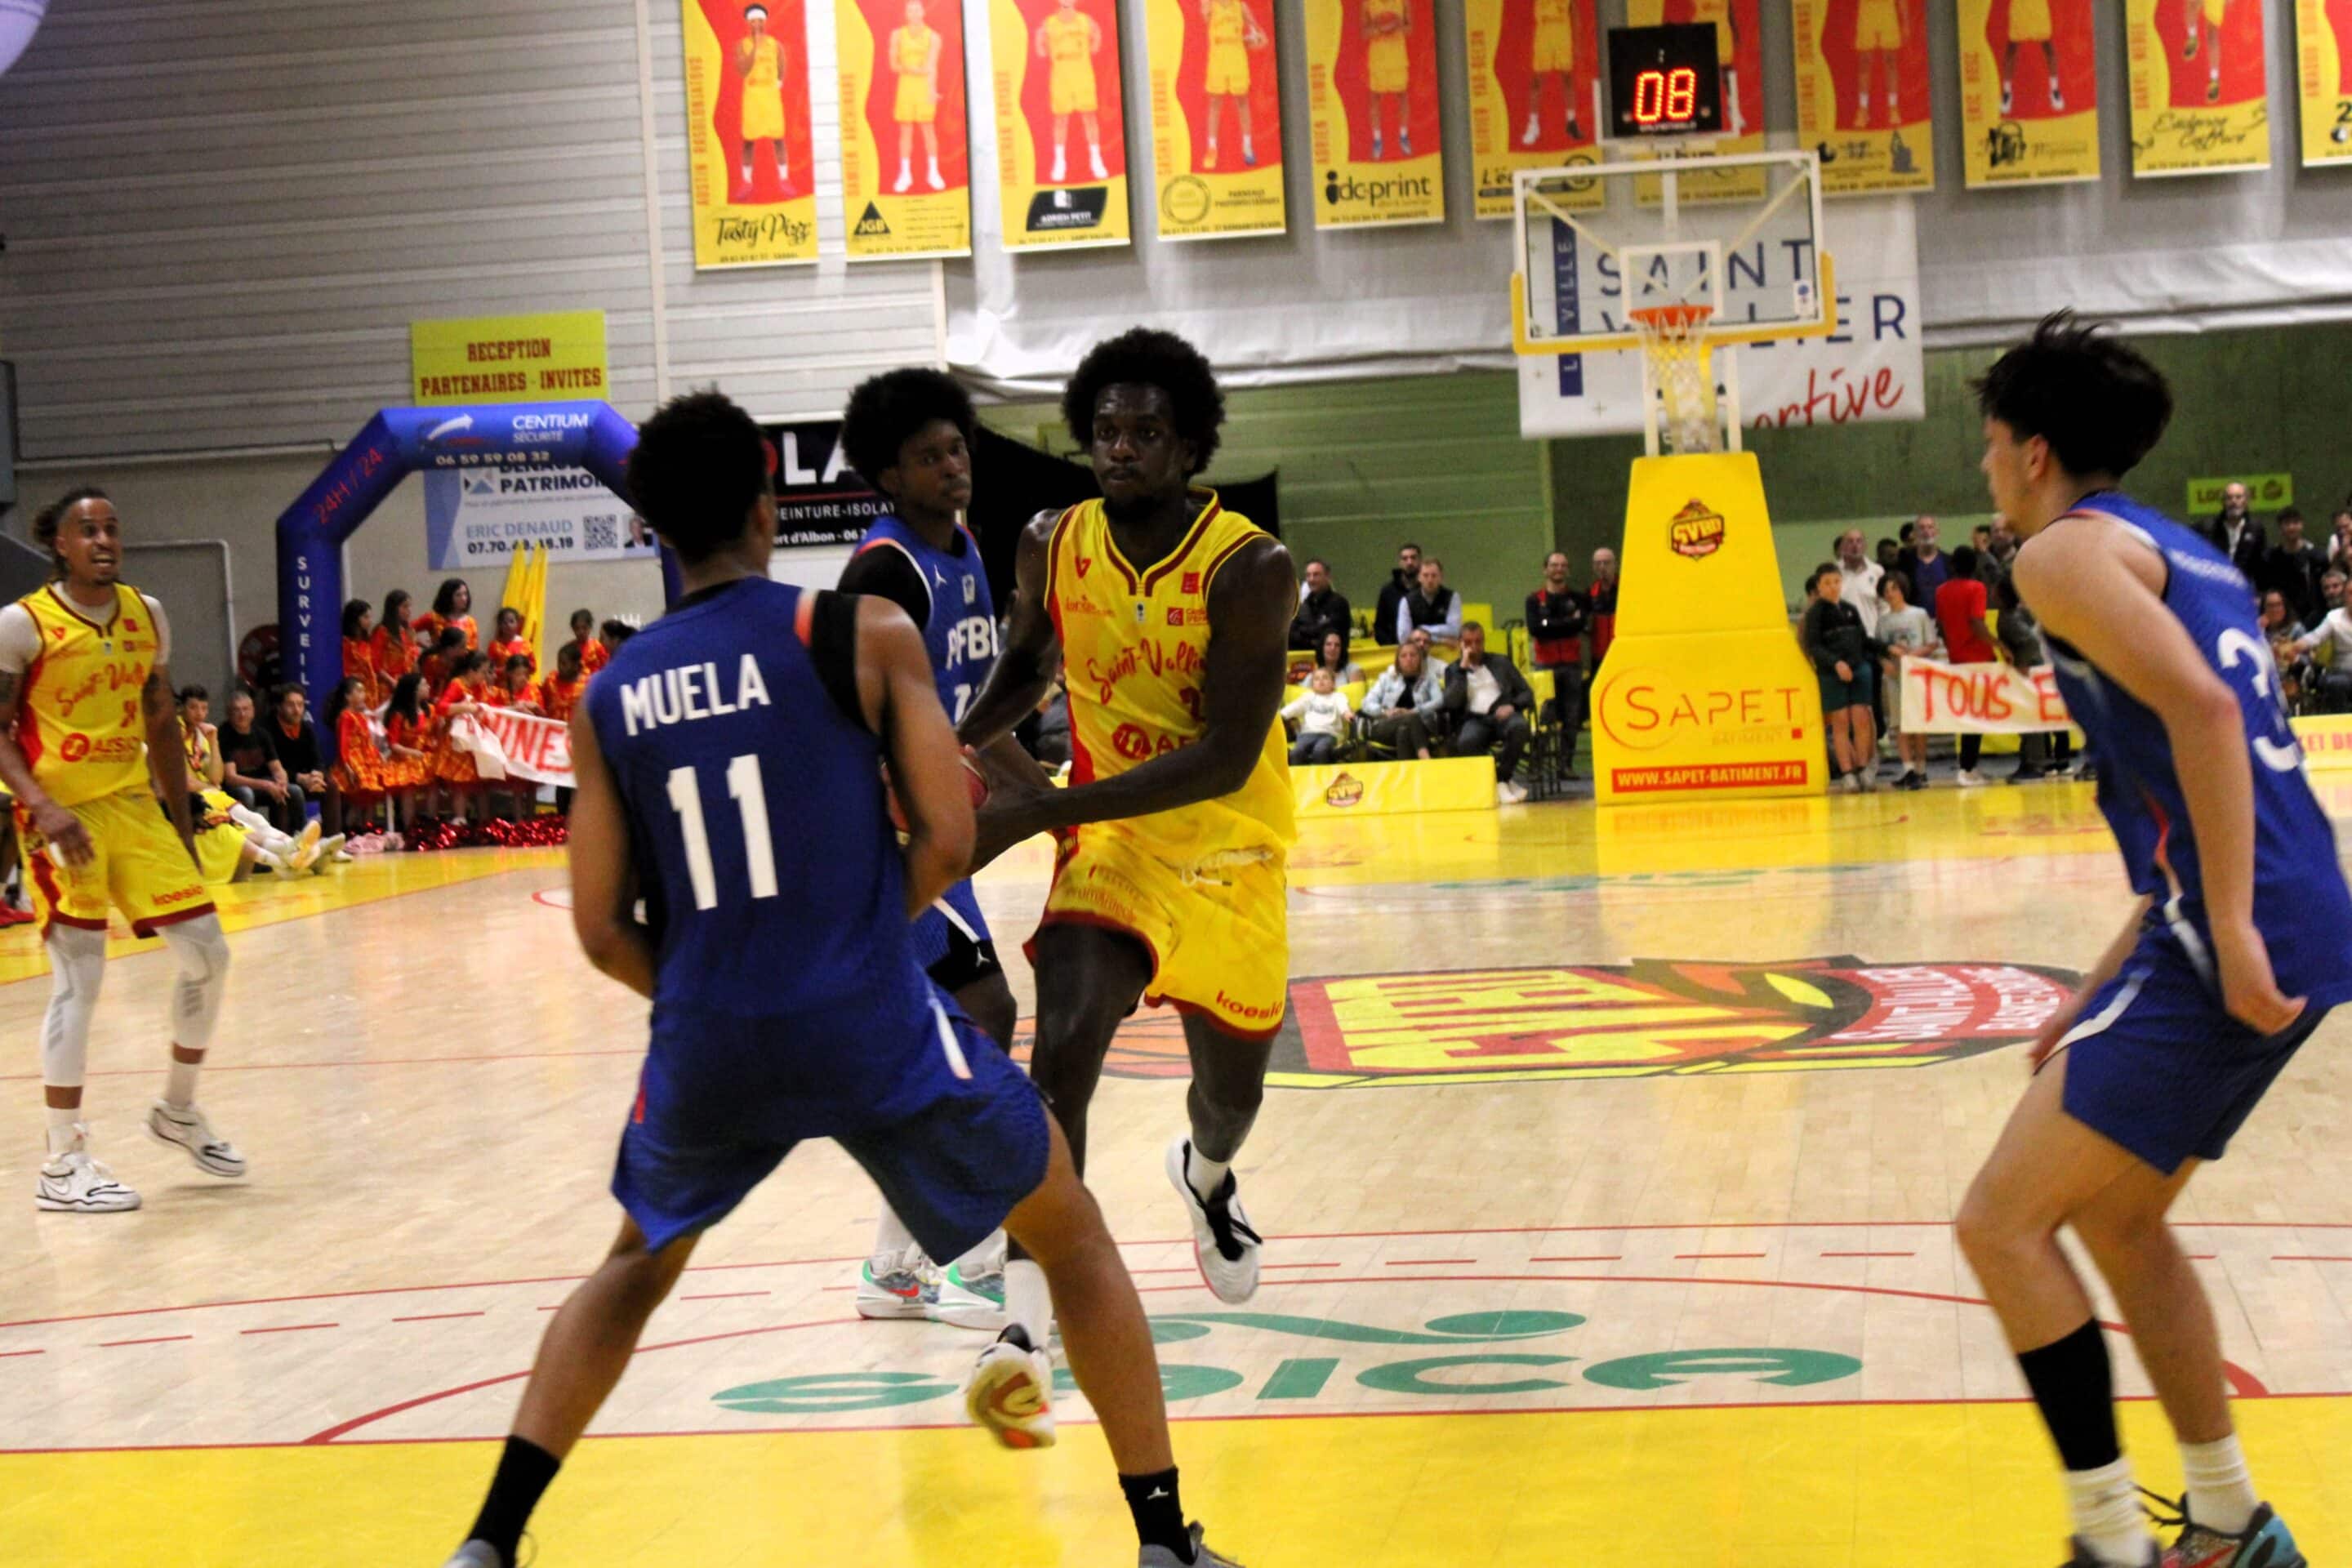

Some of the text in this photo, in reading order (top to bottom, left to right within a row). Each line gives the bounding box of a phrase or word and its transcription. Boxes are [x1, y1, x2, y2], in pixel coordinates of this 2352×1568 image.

[1634, 69, 1696, 123] 08
[859, 219, 886, 234] JGB
[467, 339, 552, 363] RECEPTION
[421, 368, 602, 397] PARTENAIRES INVITES
[512, 413, 589, 430] CENTIUM
[466, 519, 573, 539] ERIC DENAUD
[620, 653, 772, 736] MUELA
[1625, 684, 1801, 732] SAPET
[1909, 666, 2074, 724] TOUS E
[1618, 764, 1802, 787] WWW.SAPET-BATIMENT.FR
[666, 754, 779, 911] 11
